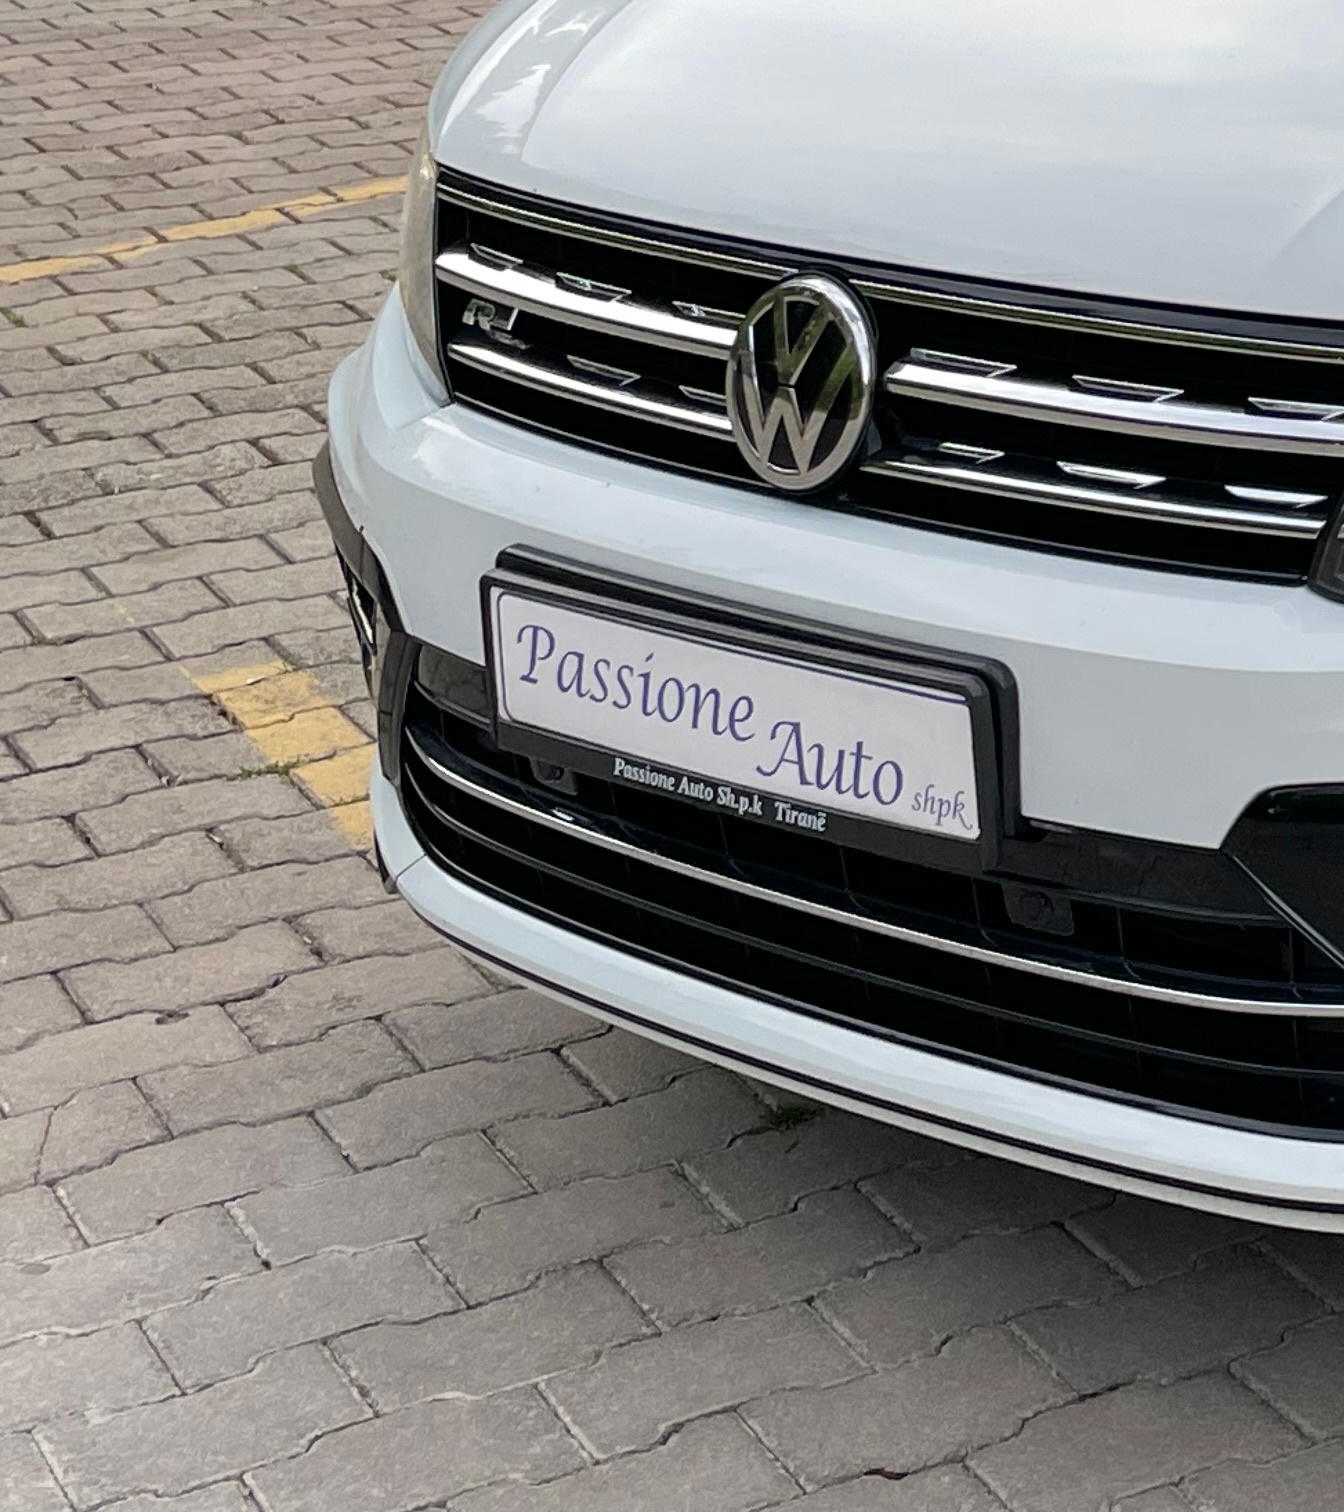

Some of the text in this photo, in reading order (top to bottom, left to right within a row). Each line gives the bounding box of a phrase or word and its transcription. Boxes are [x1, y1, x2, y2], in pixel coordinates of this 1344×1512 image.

[516, 623, 973, 830] Passione Auto shpk
[613, 756, 676, 791] Passione
[677, 778, 714, 802] Auto
[716, 787, 764, 817] Sh.p.k
